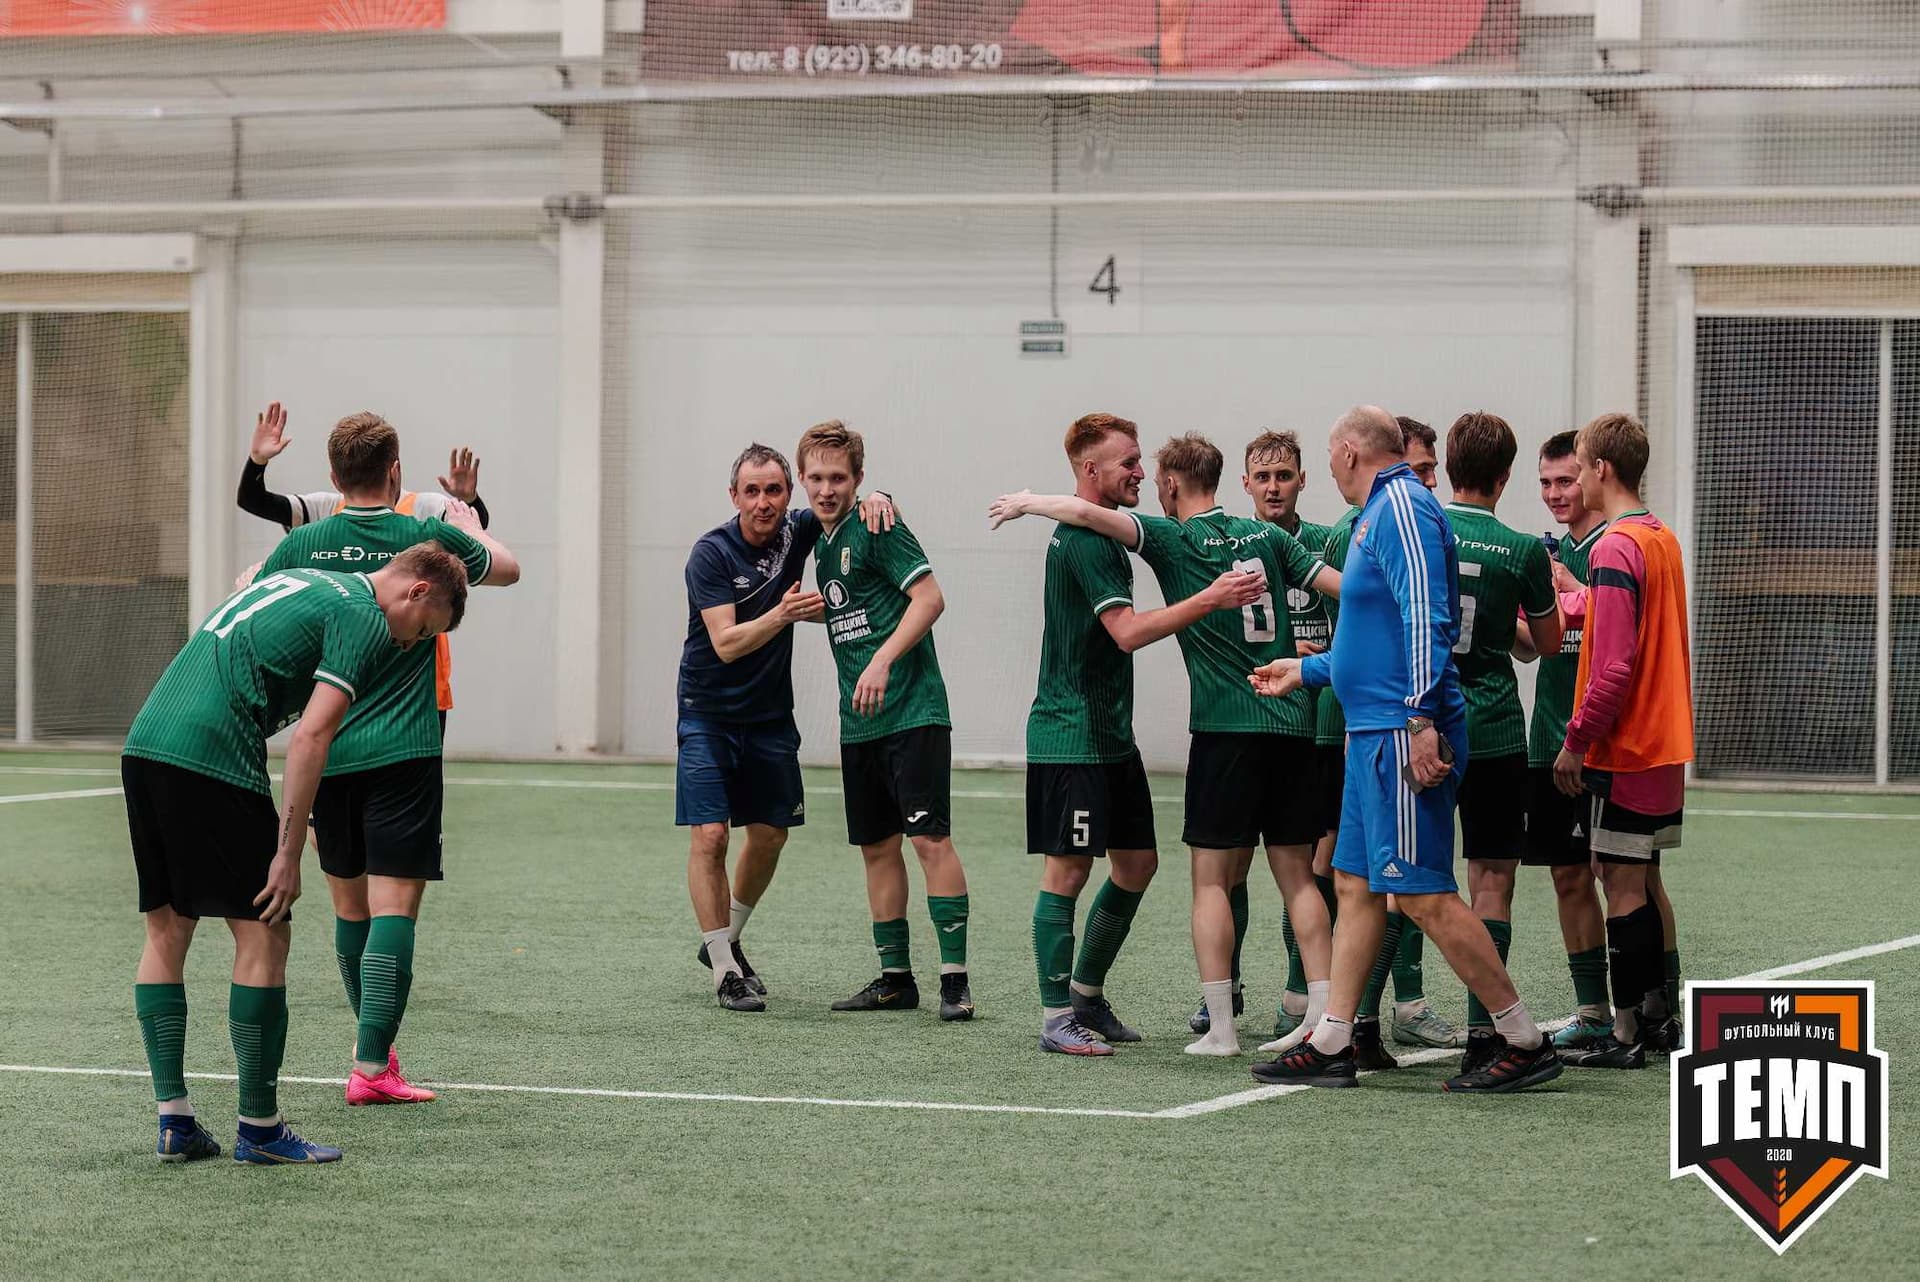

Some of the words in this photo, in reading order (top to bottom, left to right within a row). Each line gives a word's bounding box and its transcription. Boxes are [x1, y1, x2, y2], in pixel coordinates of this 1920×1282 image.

[783, 46, 800, 71] 8
[804, 44, 870, 77] (929)
[875, 44, 1003, 70] 346-80-20
[1089, 256, 1121, 305] 4
[310, 551, 339, 560] АСР
[367, 551, 401, 561] ГРУ
[1461, 540, 1511, 556] ГРУПП
[202, 573, 312, 639] 17
[1072, 810, 1090, 847] 5
